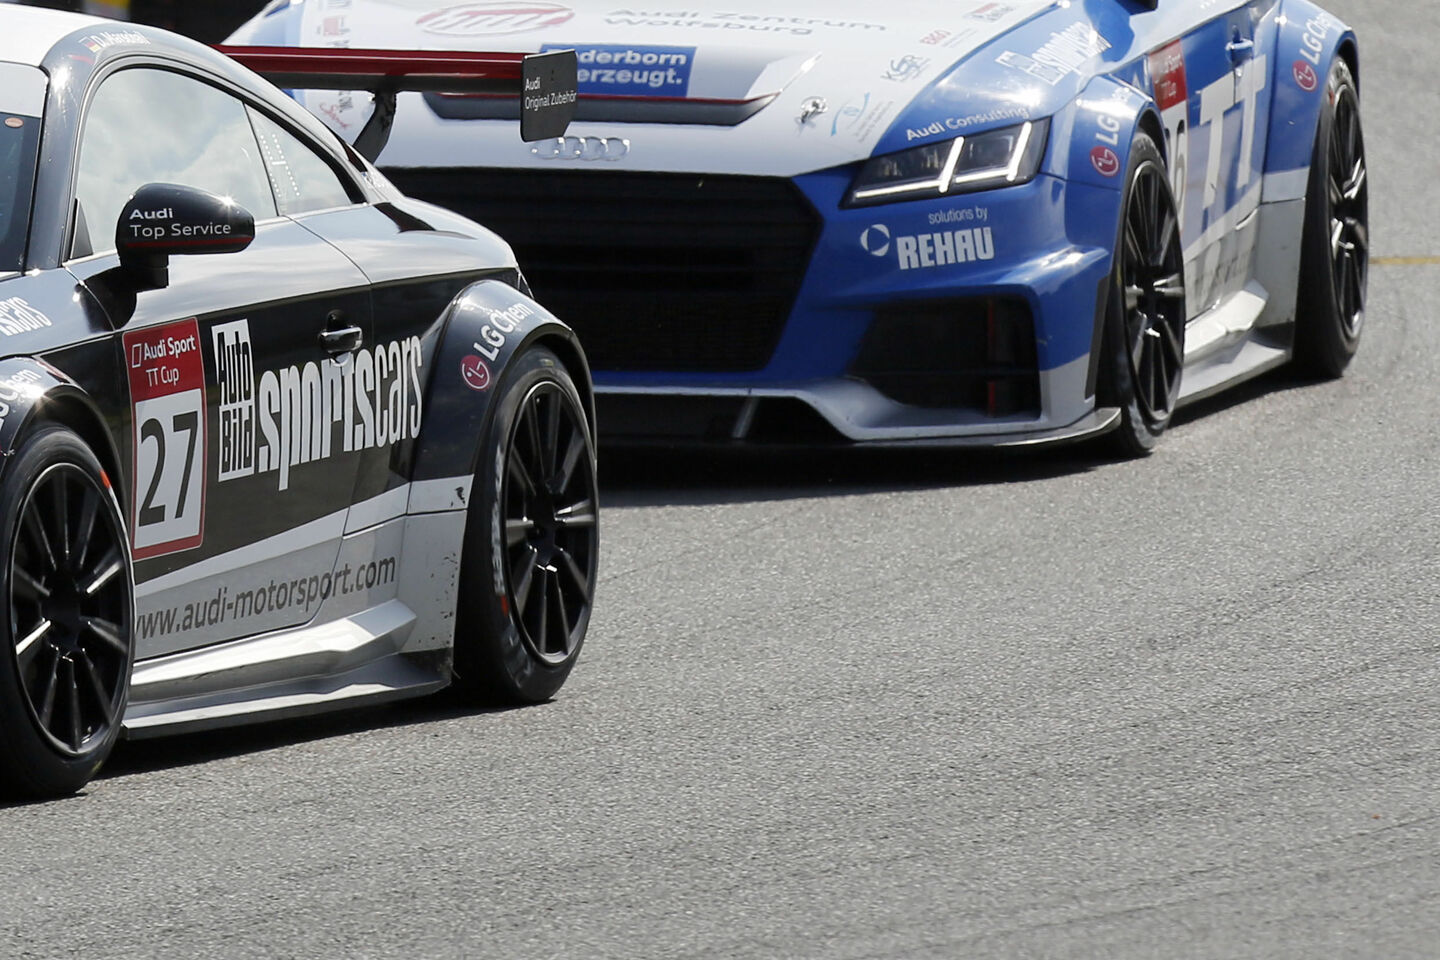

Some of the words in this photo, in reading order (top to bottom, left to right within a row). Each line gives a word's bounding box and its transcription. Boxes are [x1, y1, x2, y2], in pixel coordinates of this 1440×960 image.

[578, 49, 687, 65] derborn
[525, 76, 541, 91] Audi
[577, 67, 683, 88] erzeugt.
[525, 95, 550, 112] Original
[906, 123, 946, 141] Audi
[945, 107, 1031, 131] Consulting
[129, 208, 174, 220] Audi
[928, 209, 974, 224] solutions
[975, 206, 988, 220] by
[130, 224, 165, 239] Top
[171, 222, 231, 237] Service
[896, 227, 994, 271] REHAU
[489, 303, 534, 333] Chem
[144, 342, 166, 360] Audi
[168, 334, 196, 357] Sport
[473, 325, 506, 361] LG
[146, 368, 159, 387] TT
[160, 366, 179, 386] Cup
[258, 335, 422, 491] sportscars
[138, 410, 199, 527] 27
